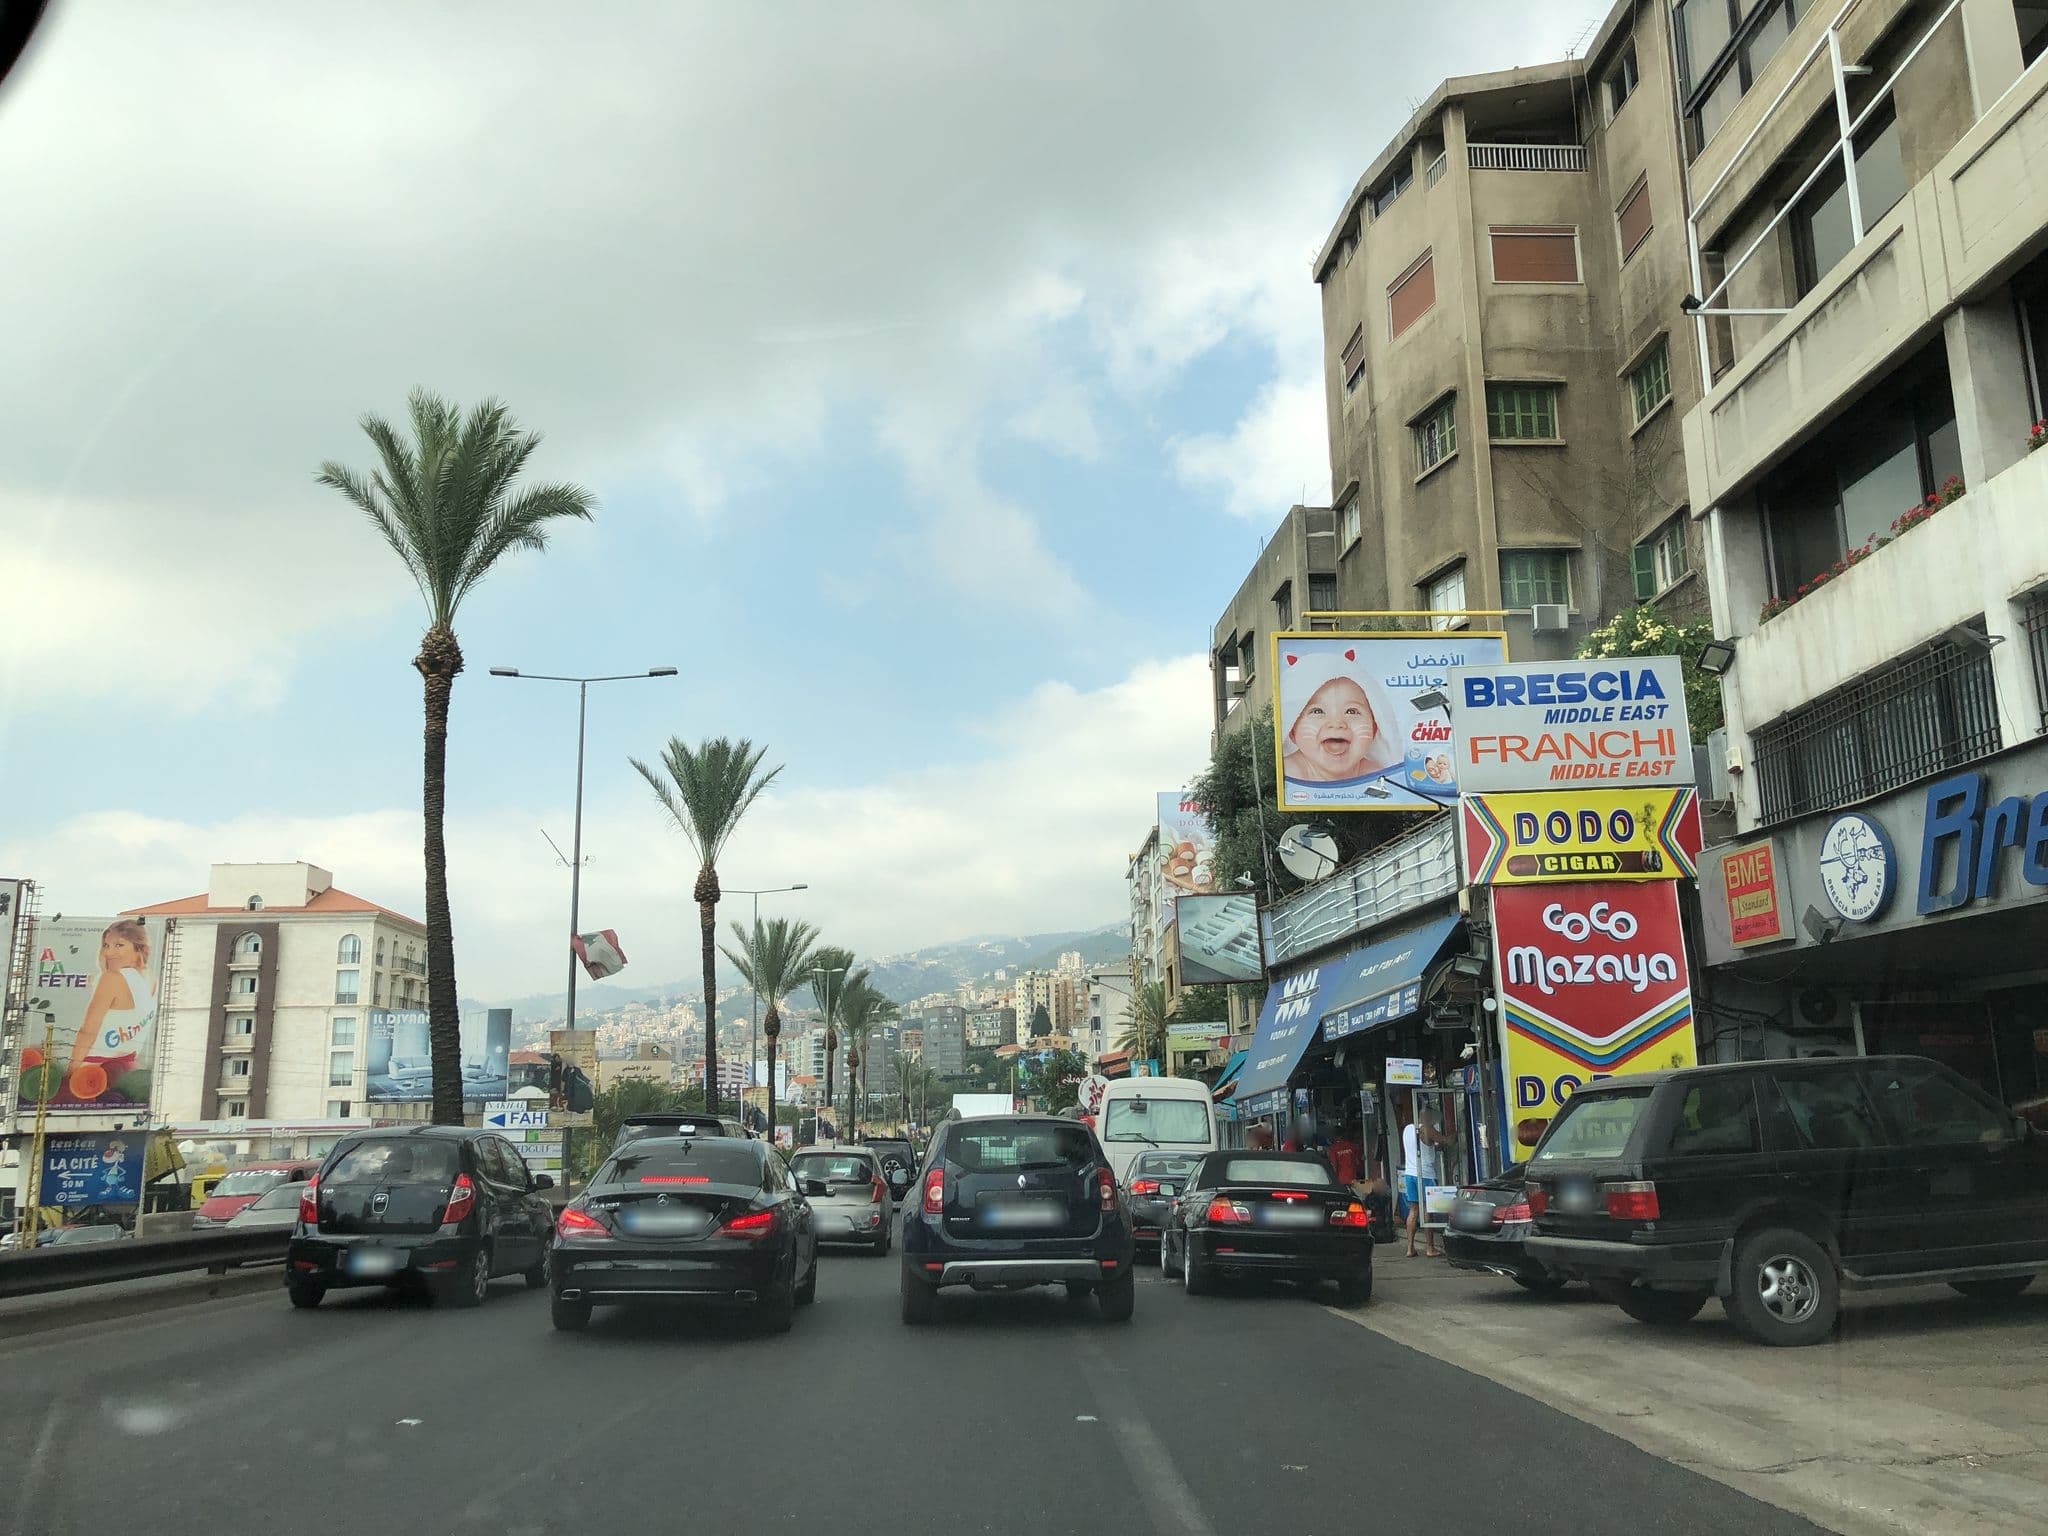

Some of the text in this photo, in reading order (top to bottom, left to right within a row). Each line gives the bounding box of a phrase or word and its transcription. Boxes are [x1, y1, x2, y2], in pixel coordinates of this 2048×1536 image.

[1407, 653, 1464, 669] الأفضل
[1386, 675, 1443, 687] عائلتك
[1464, 669, 1666, 707] BRESCIA
[1544, 704, 1669, 724] MIDDLE EAST
[1411, 727, 1451, 741] CHAT
[1470, 728, 1676, 764] FRANCHI
[1550, 760, 1675, 780] MIDDLE EAST
[1514, 809, 1635, 846] DODO
[1544, 855, 1616, 871] CIGAR
[1727, 851, 1768, 889] BME
[1827, 879, 1848, 913] BRESCIA
[1852, 899, 1875, 916] MIDDLE
[40, 948, 54, 960] A
[39, 961, 64, 973] LA
[50, 1155, 99, 1170] LA CITÉ
[75, 1180, 84, 1188] M
